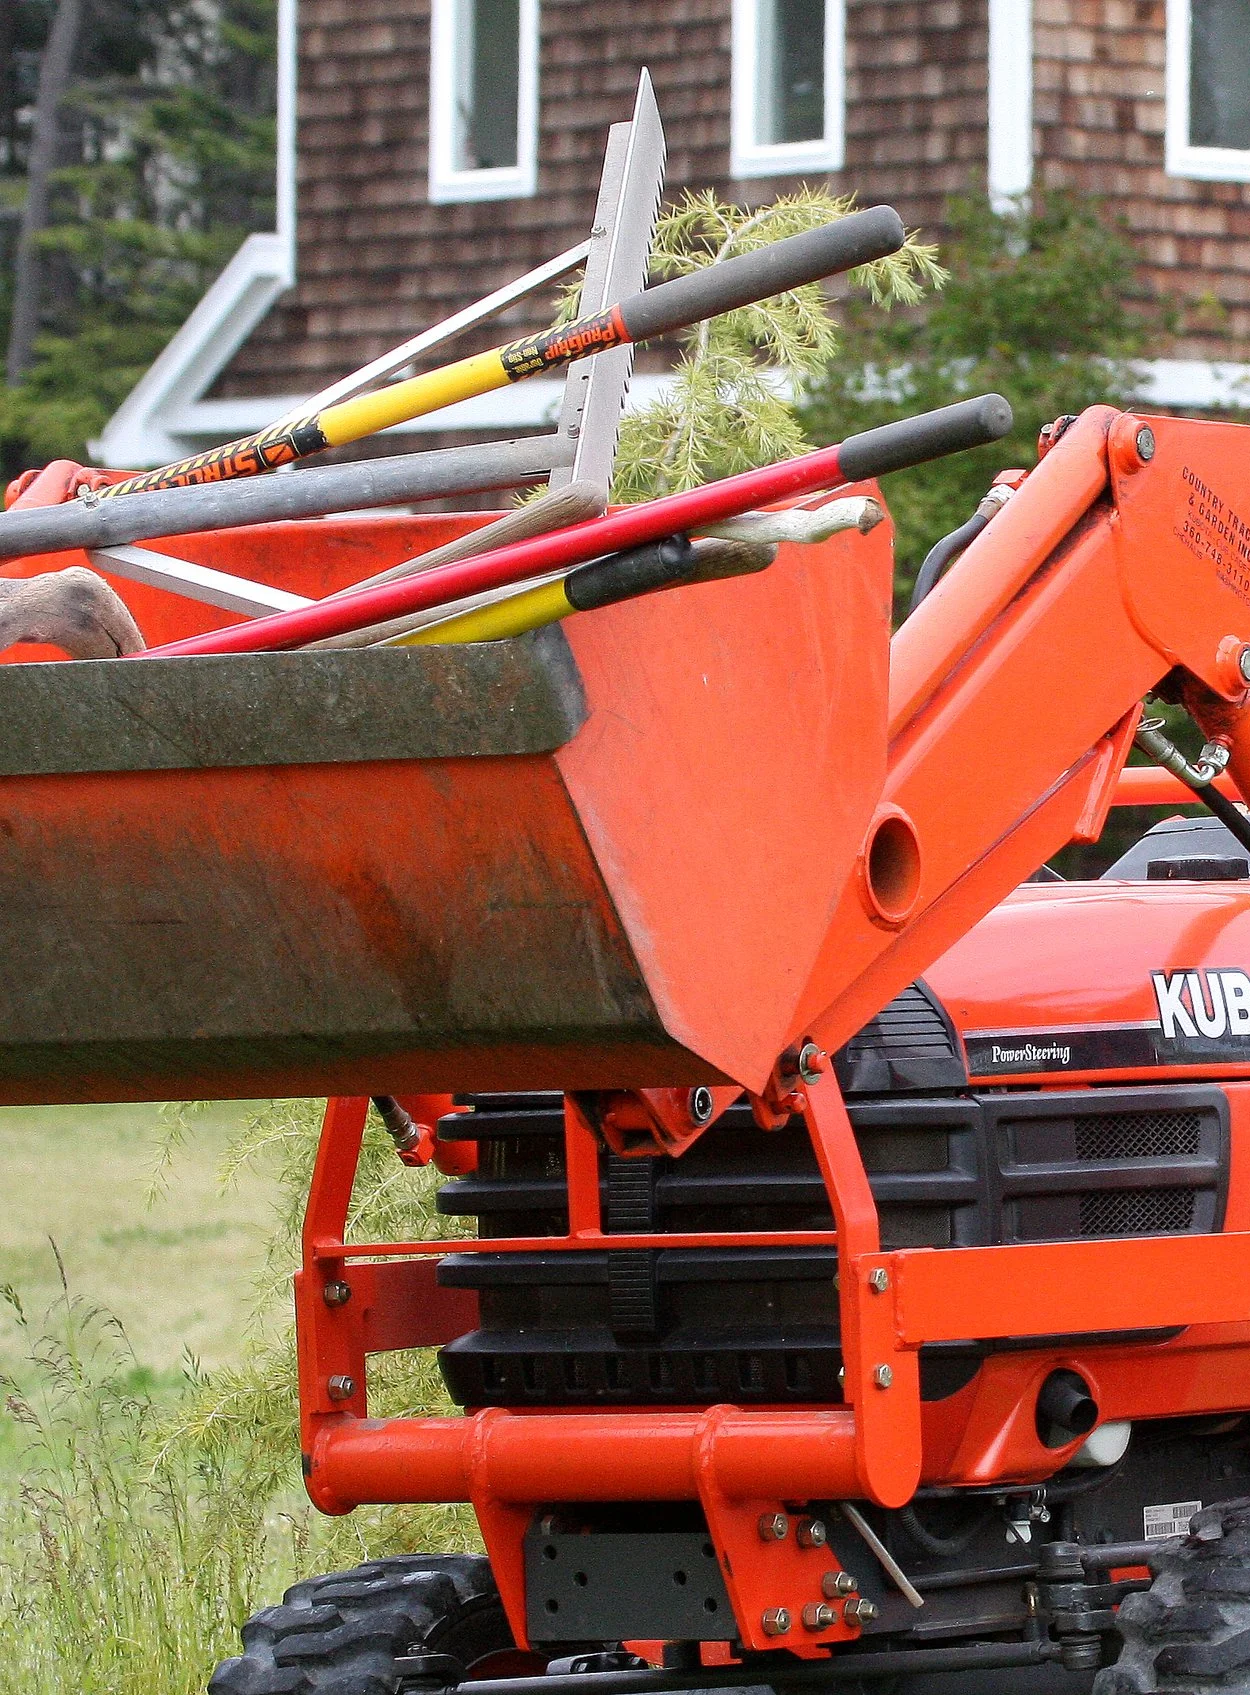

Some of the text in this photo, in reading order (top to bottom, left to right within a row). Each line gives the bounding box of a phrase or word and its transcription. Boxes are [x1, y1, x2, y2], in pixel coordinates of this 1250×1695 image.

[1182, 466, 1224, 514] COUNTRY
[1199, 502, 1235, 545] GARDEN
[1183, 520, 1250, 592] 360-748-3110
[991, 1042, 1071, 1065] PowerSteering
